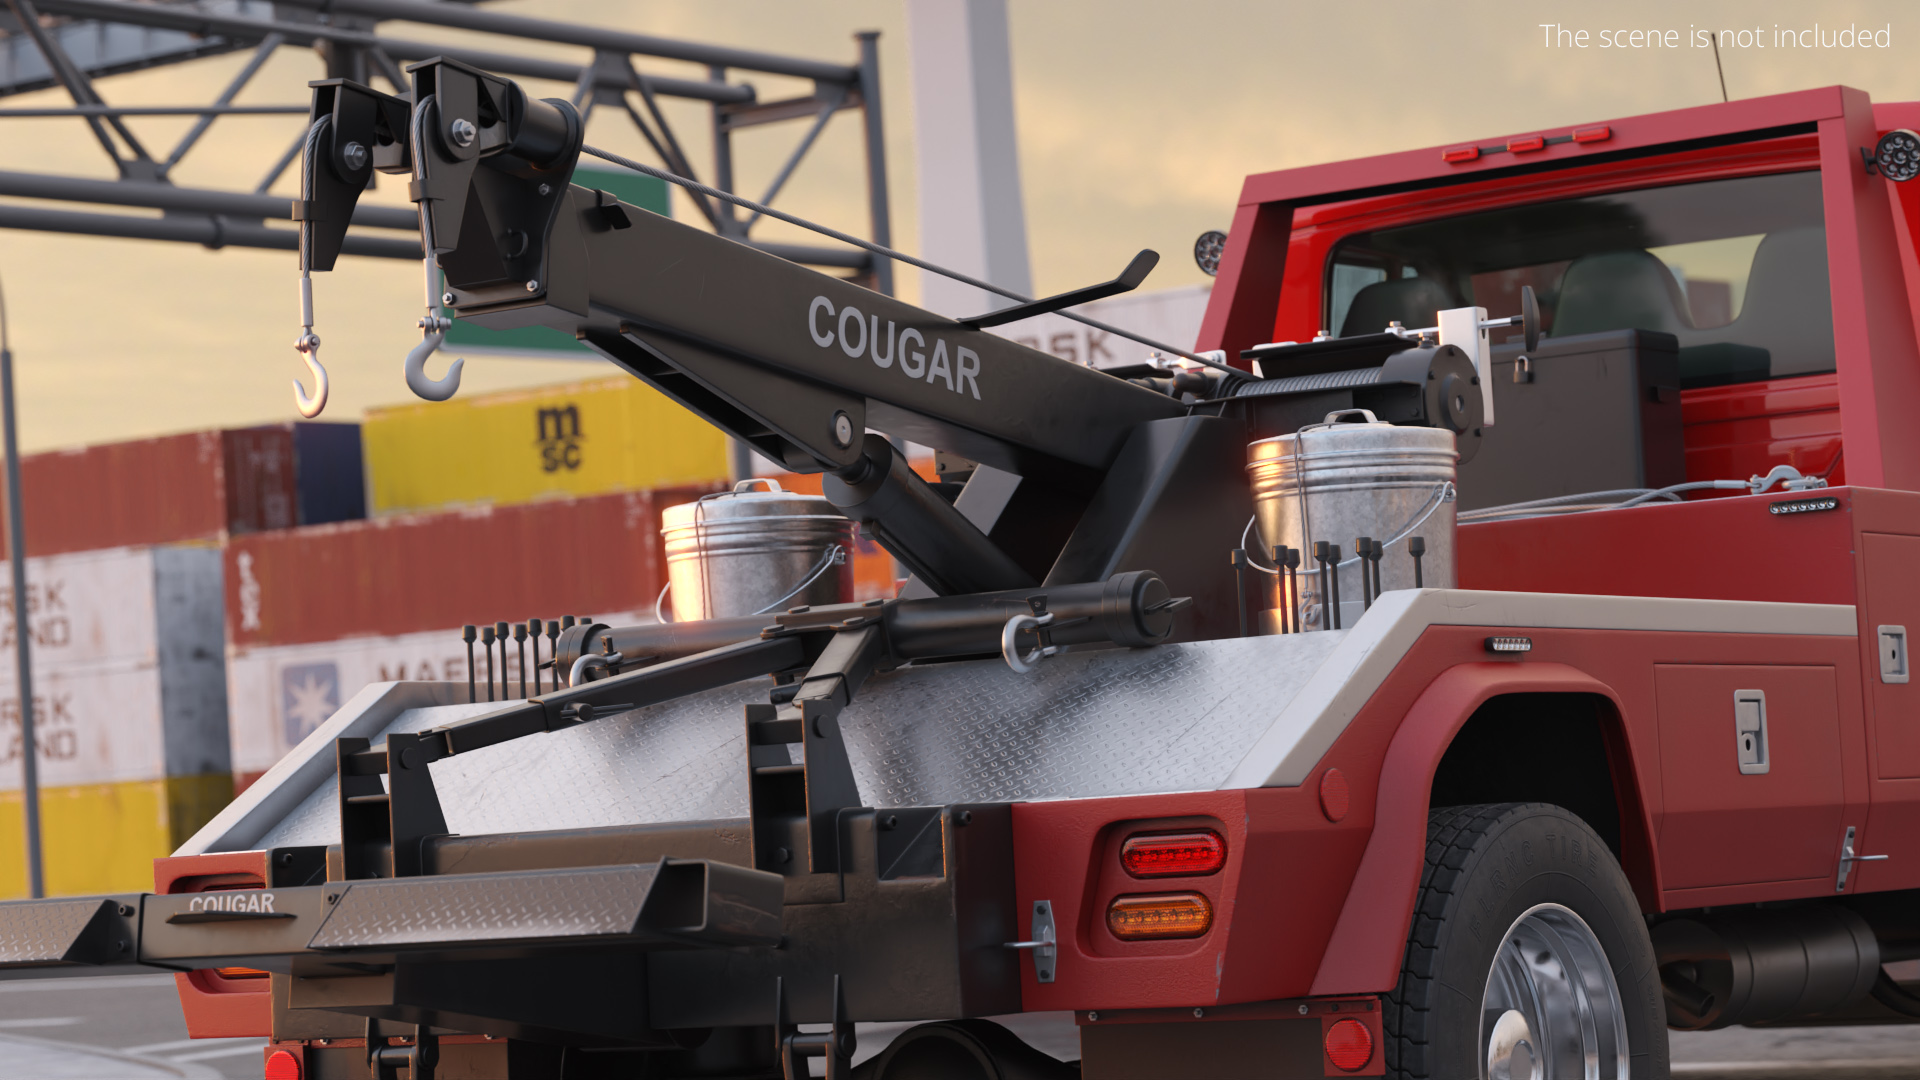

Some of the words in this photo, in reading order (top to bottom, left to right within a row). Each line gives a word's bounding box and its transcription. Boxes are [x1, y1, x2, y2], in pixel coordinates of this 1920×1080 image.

[808, 295, 982, 400] COUGAR
[1545, 832, 1599, 879] TIRE
[189, 892, 275, 913] COUGAR
